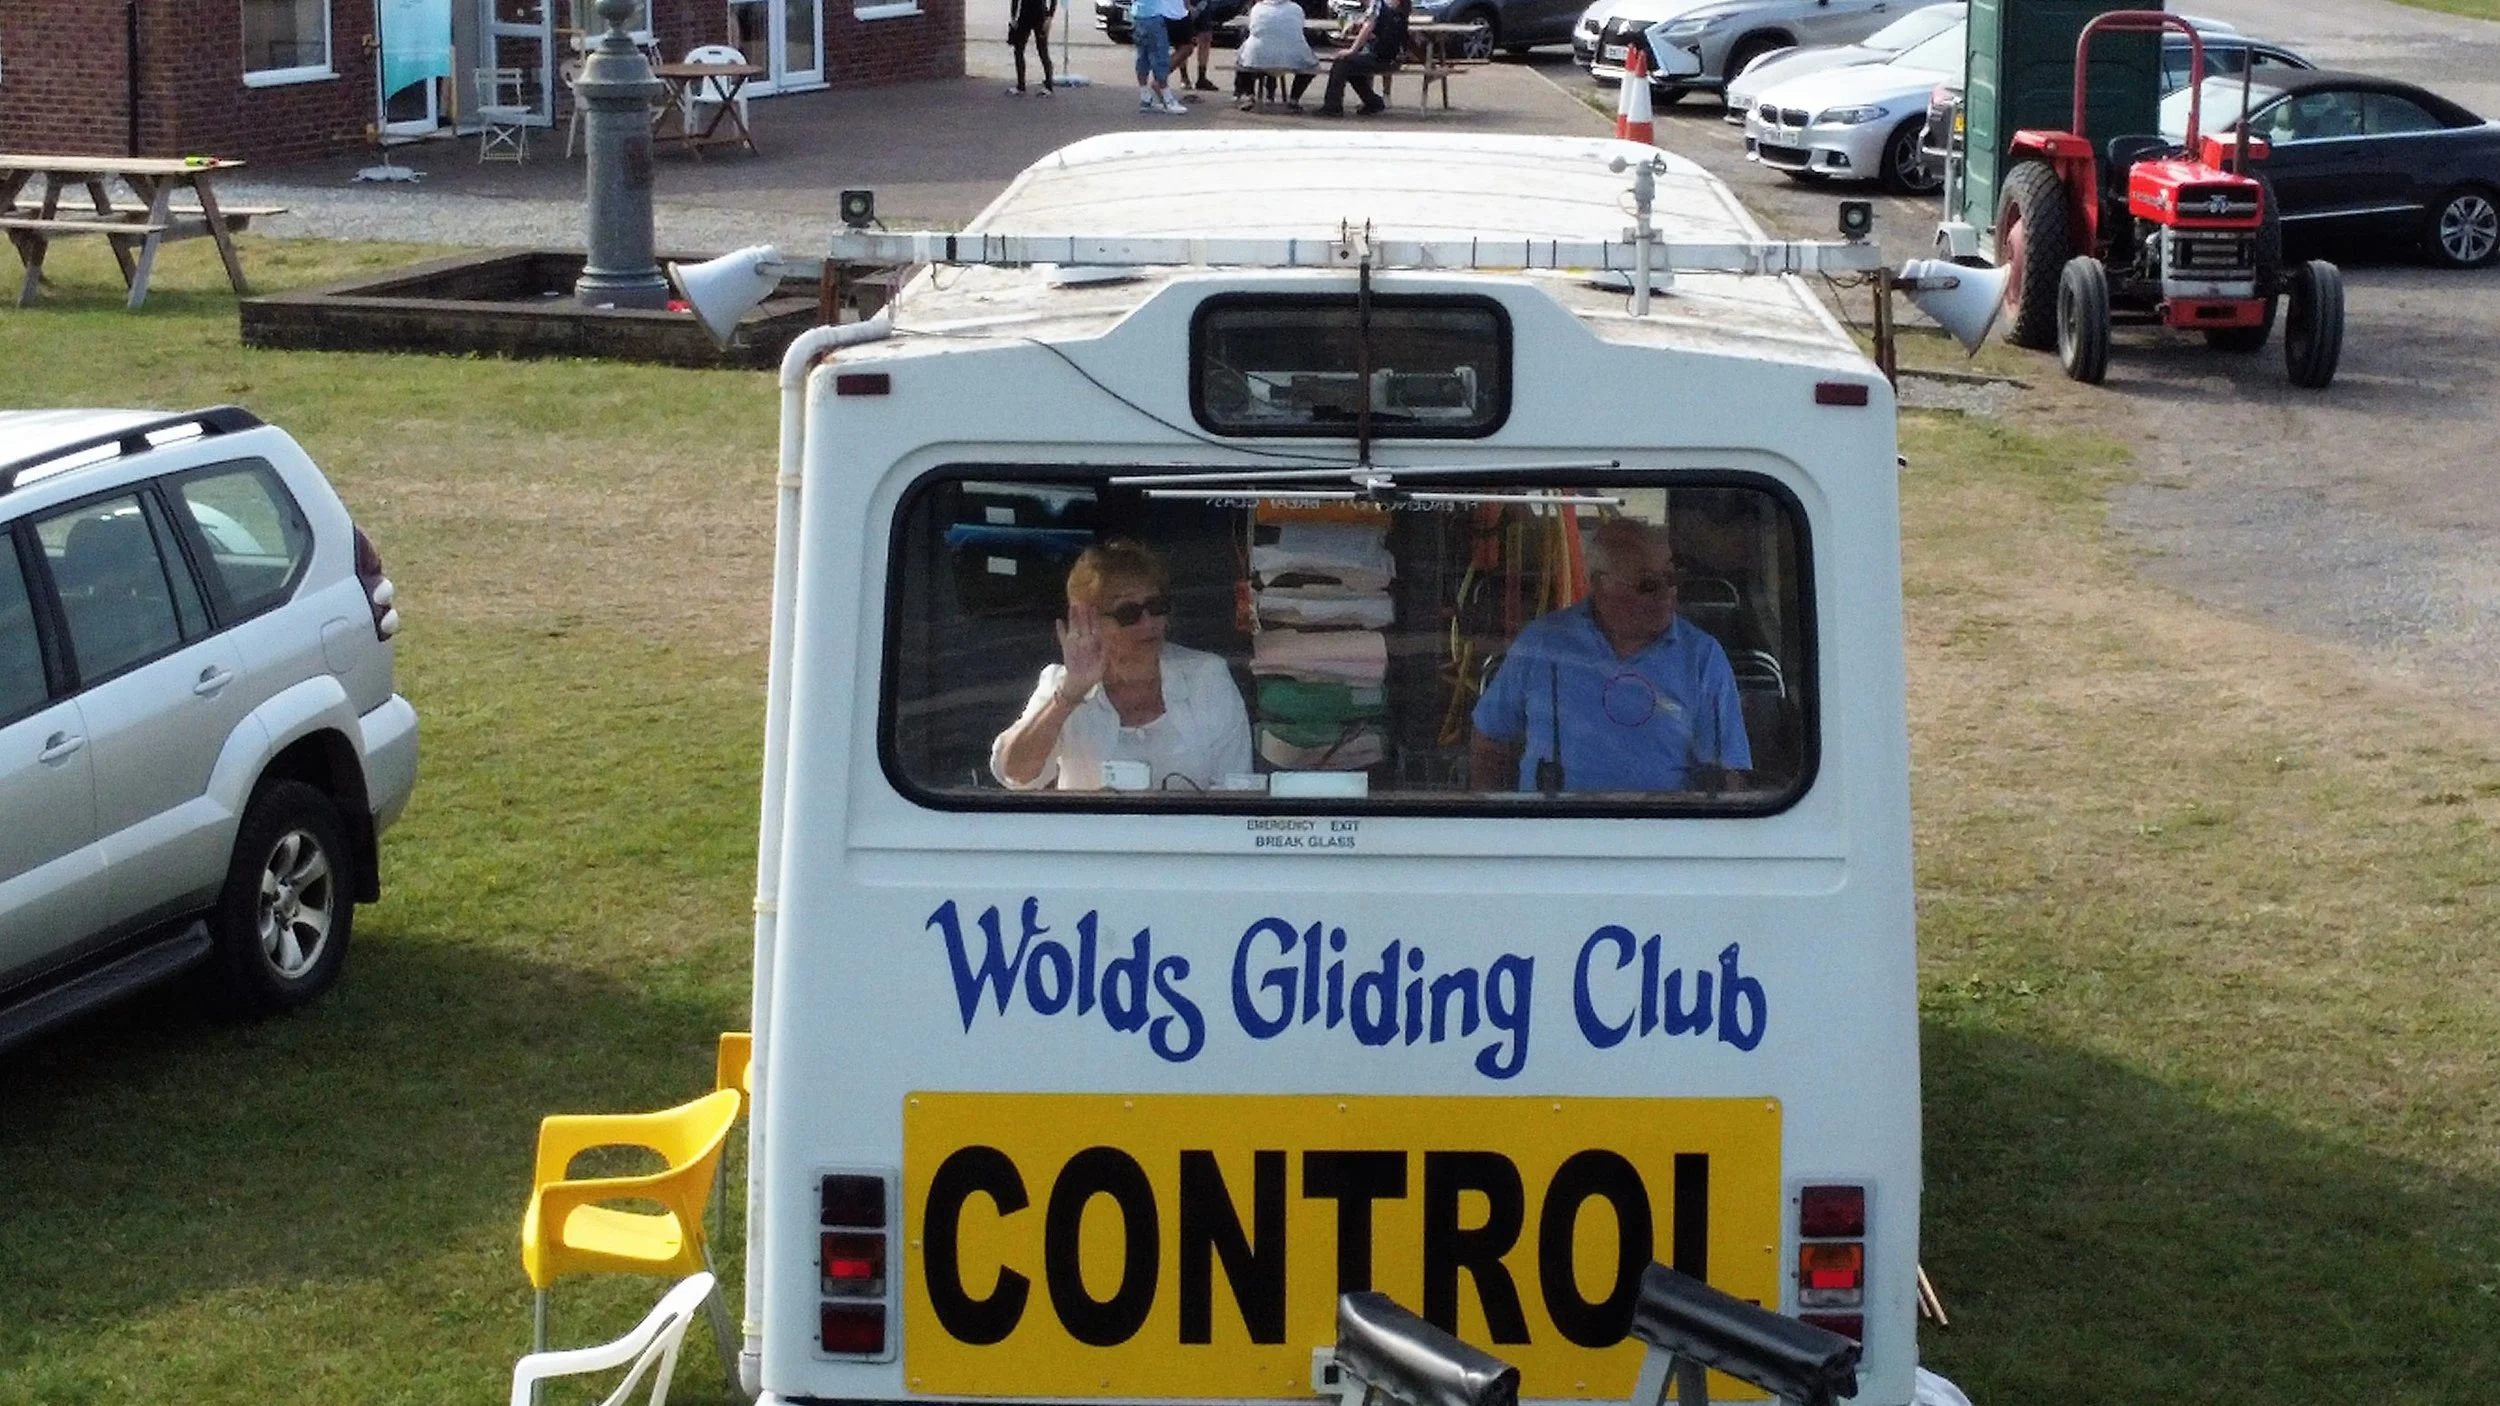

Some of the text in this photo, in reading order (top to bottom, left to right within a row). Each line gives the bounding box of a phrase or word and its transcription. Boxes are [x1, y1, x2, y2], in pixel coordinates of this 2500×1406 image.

[1330, 820, 1360, 832] EXIT
[1255, 836, 1356, 849] BREAK GLASS
[926, 895, 1768, 1081] Wolds Gliding Club
